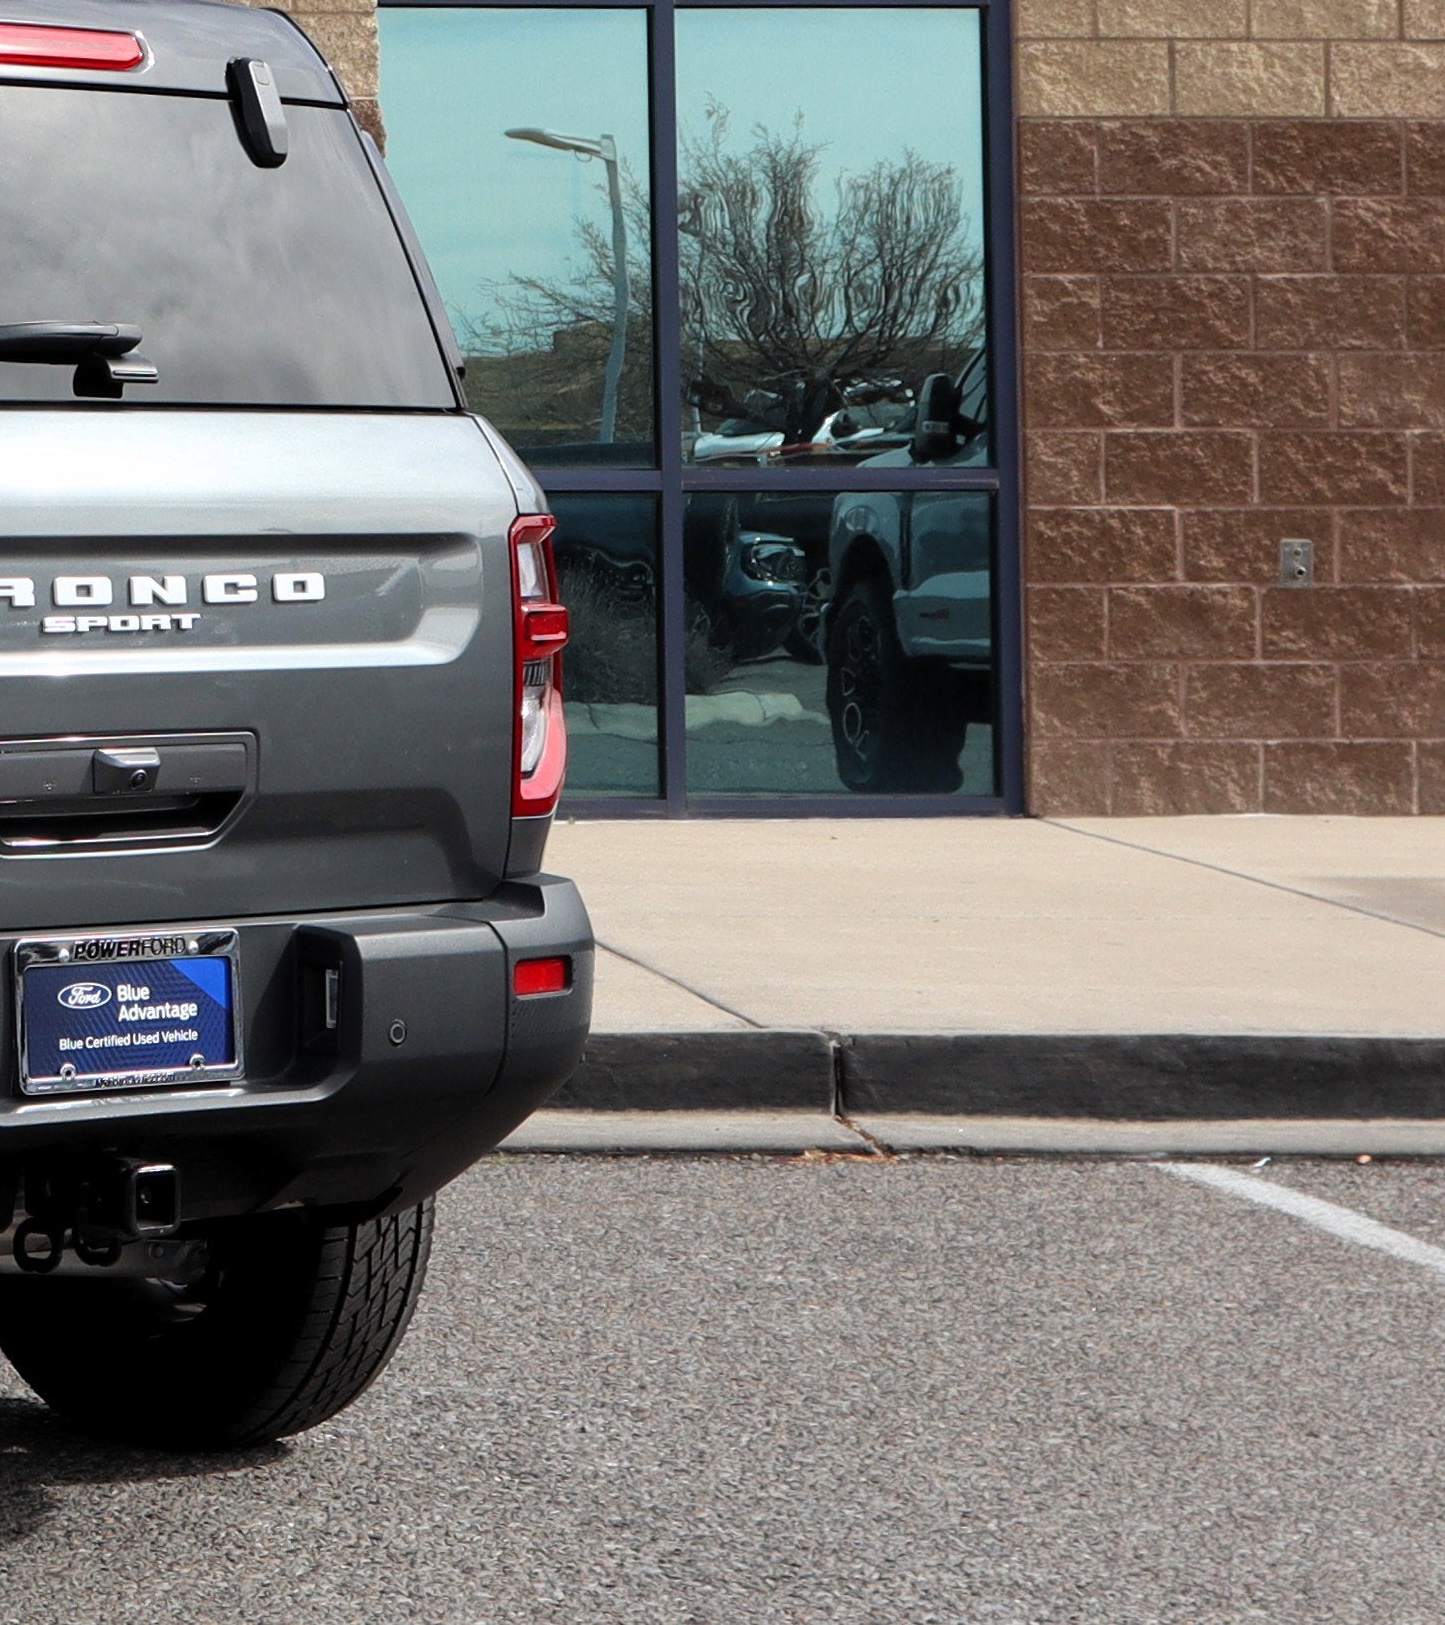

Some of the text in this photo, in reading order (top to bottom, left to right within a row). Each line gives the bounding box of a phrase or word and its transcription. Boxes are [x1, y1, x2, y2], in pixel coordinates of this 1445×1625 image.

[41, 612, 203, 633] SPORT
[67, 986, 102, 1006] Ford
[116, 984, 150, 1002] Blue
[118, 1002, 198, 1022] Advantage
[59, 1028, 198, 1051] Blue Certified Used Vehicle
